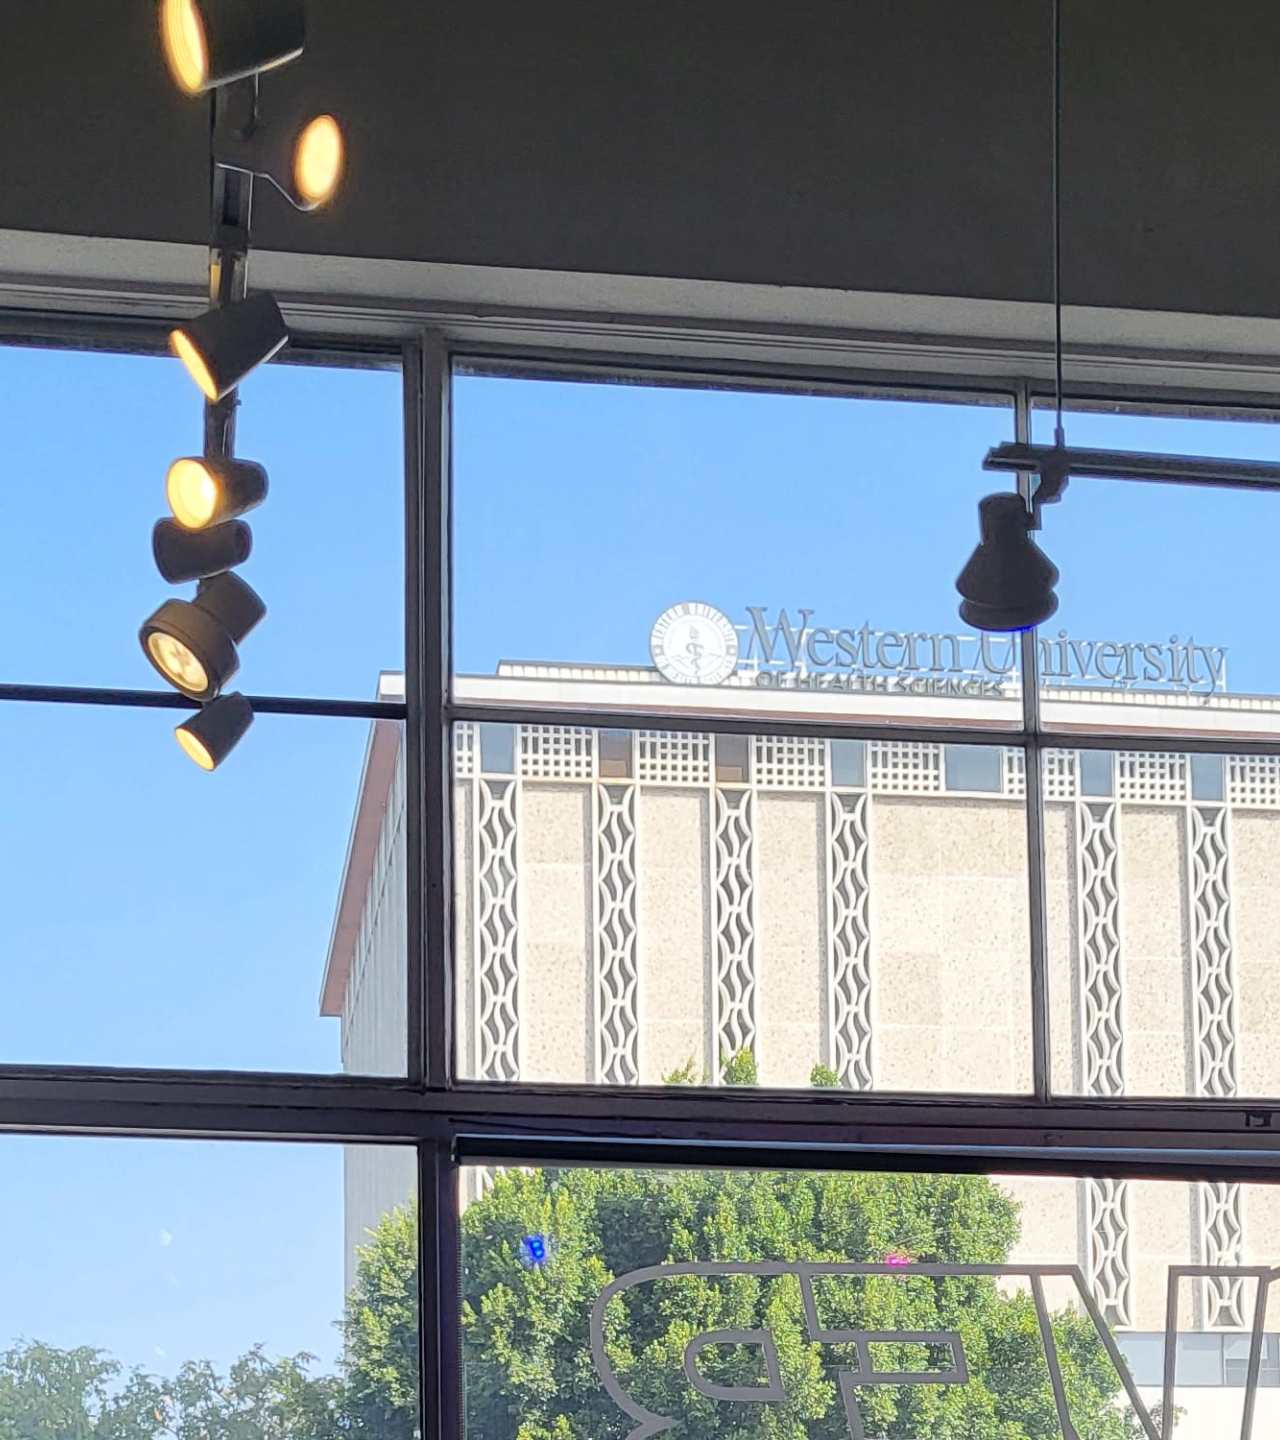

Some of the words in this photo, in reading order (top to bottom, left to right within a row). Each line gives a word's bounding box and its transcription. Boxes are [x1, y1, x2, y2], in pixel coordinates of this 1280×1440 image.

[745, 606, 963, 672] Western
[972, 628, 1230, 705] University
[756, 671, 791, 689] OF
[799, 672, 887, 693] HEALTH
[890, 675, 1004, 697] SCIENCES
